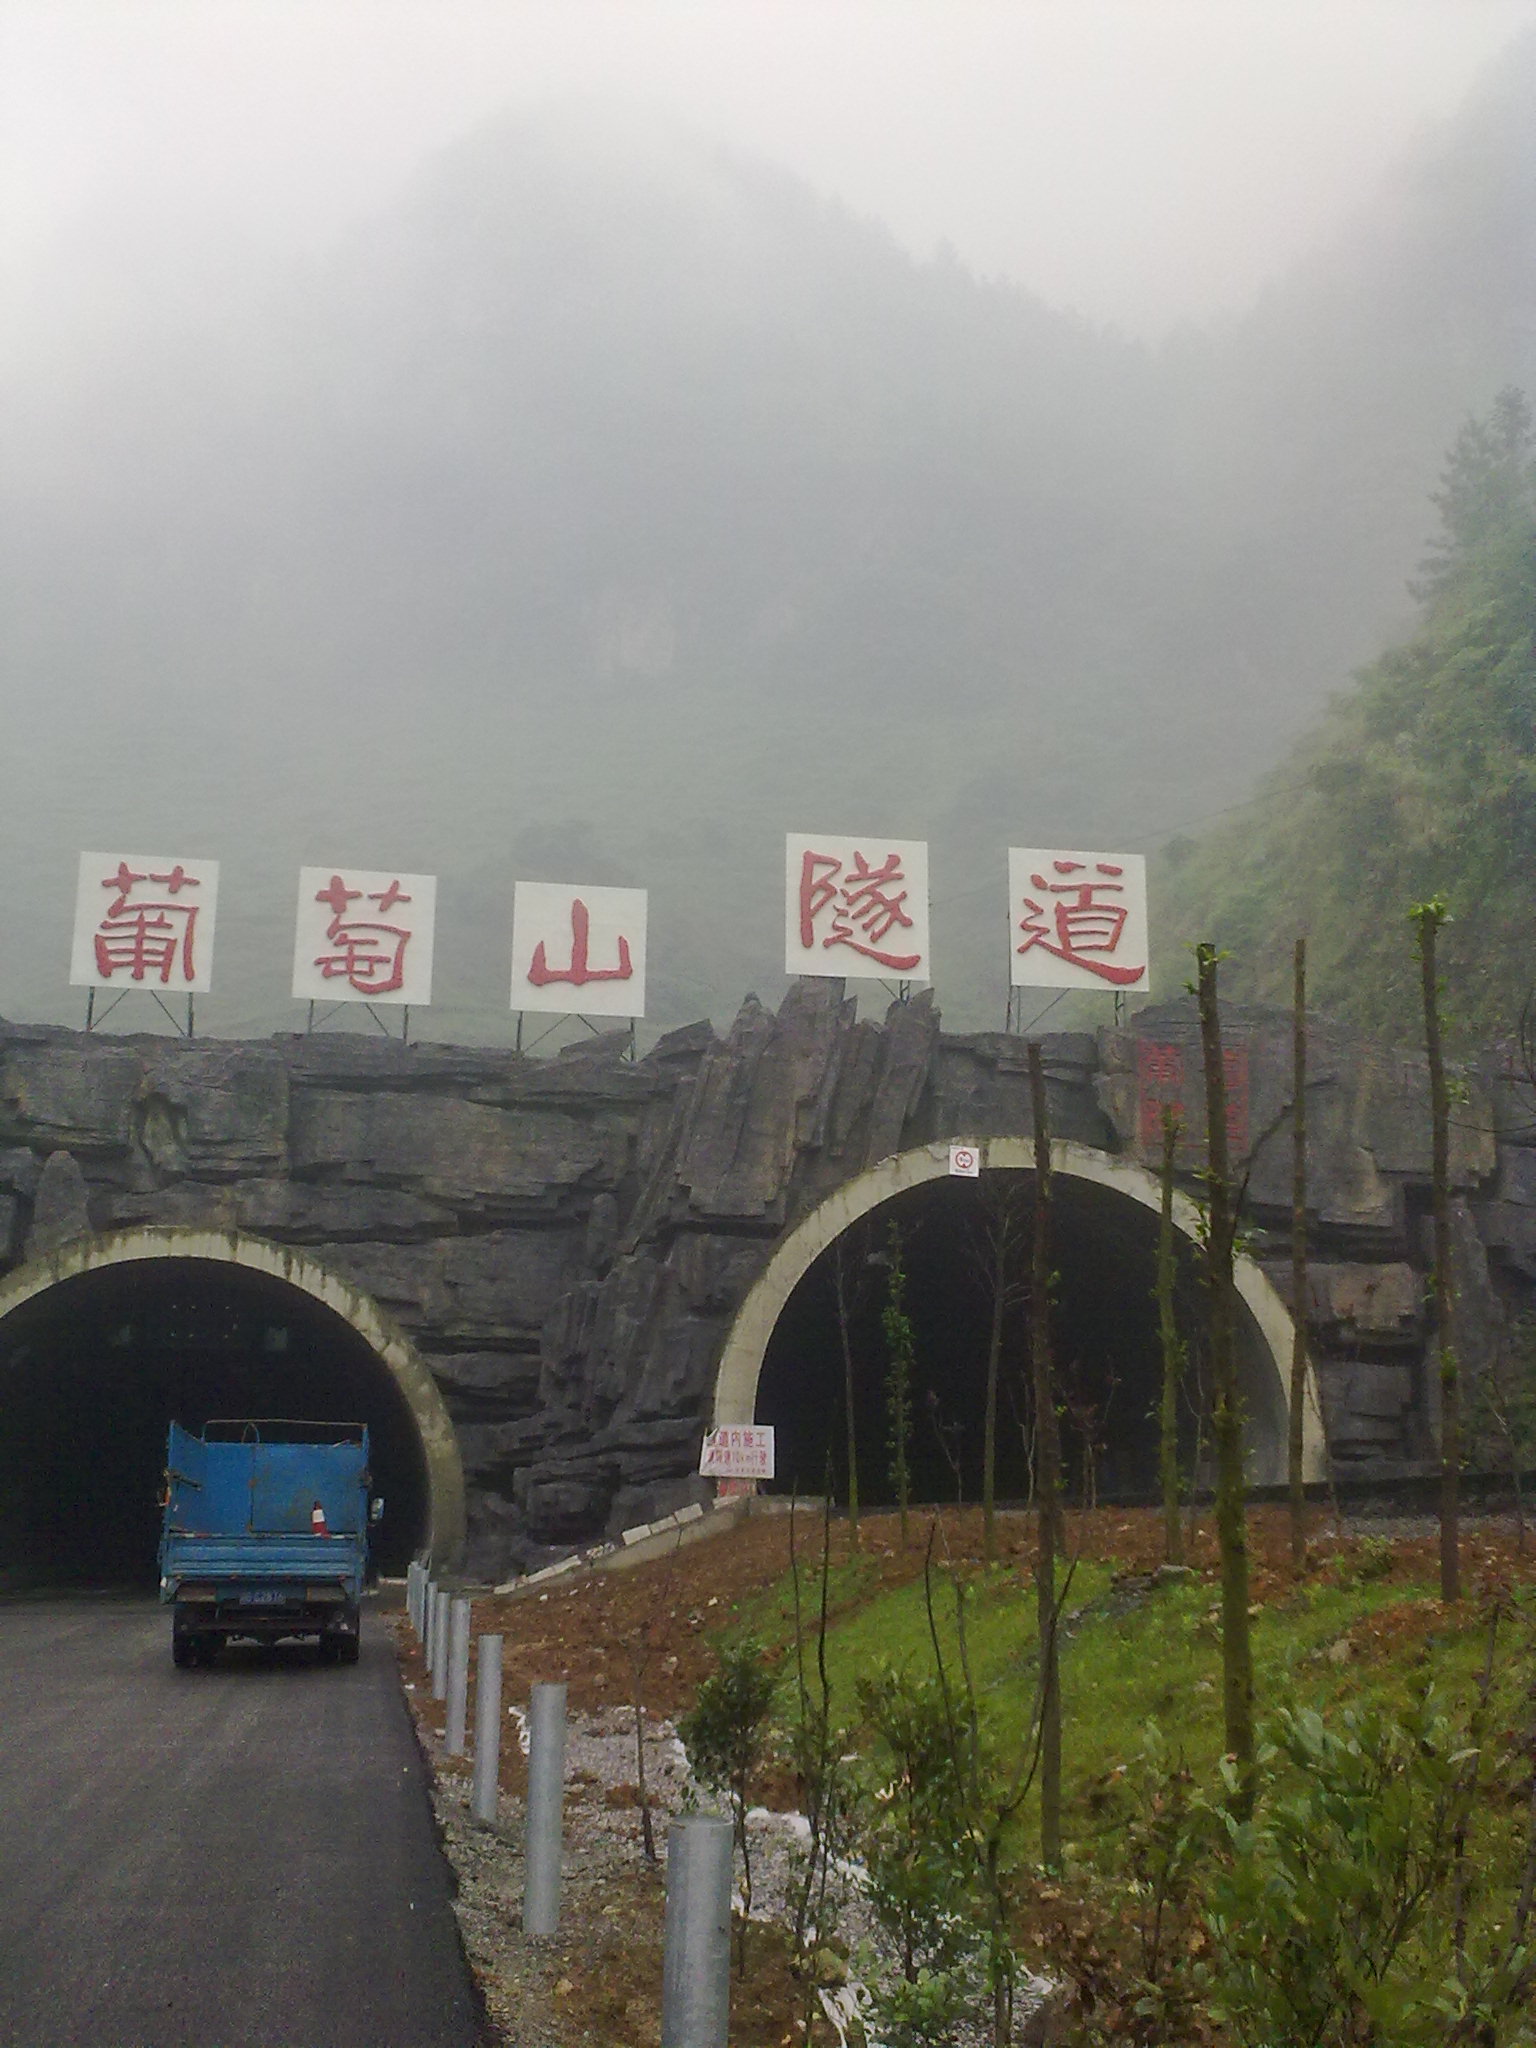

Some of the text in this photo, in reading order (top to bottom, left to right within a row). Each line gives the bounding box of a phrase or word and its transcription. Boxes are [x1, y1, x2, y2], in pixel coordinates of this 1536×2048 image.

[93, 850, 1146, 995] 葡萄山隧道
